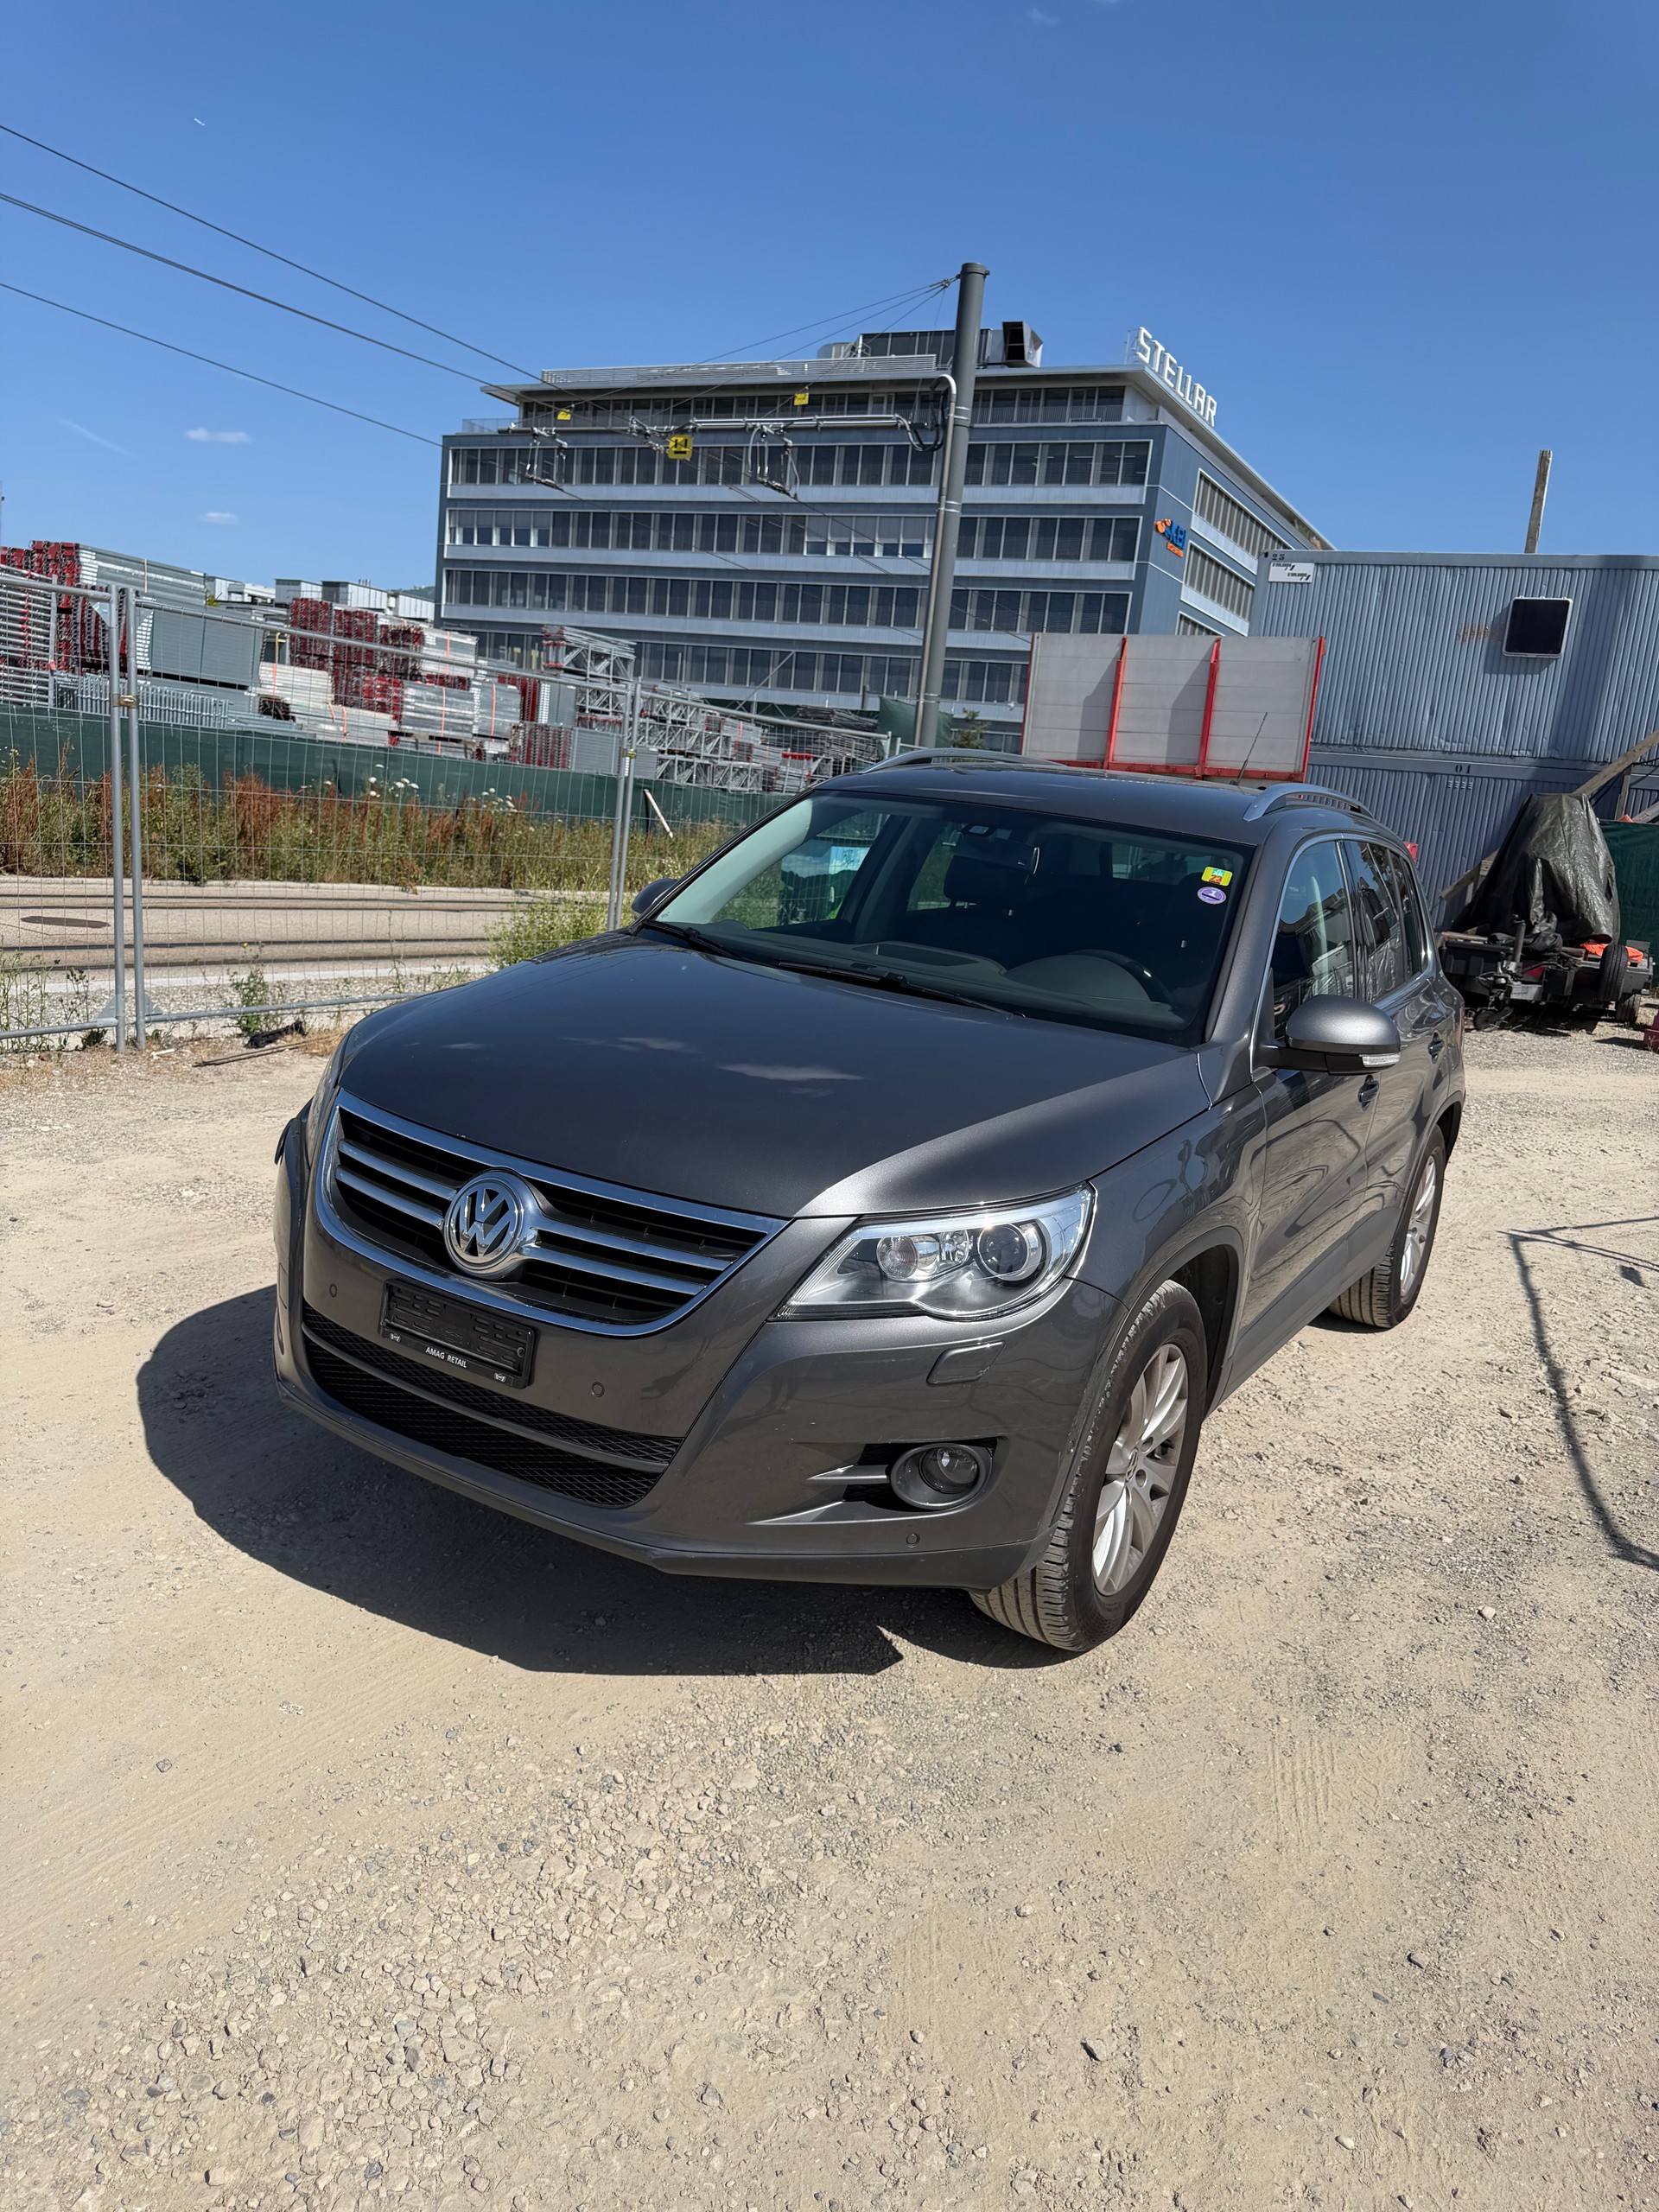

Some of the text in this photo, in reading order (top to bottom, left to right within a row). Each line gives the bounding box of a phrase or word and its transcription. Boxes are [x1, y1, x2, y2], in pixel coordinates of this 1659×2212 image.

[1136, 327, 1217, 428] STELLAR
[1209, 874, 1223, 884] 23
[451, 1181, 523, 1265] VW
[425, 1346, 467, 1369] AMAG RETAIL
